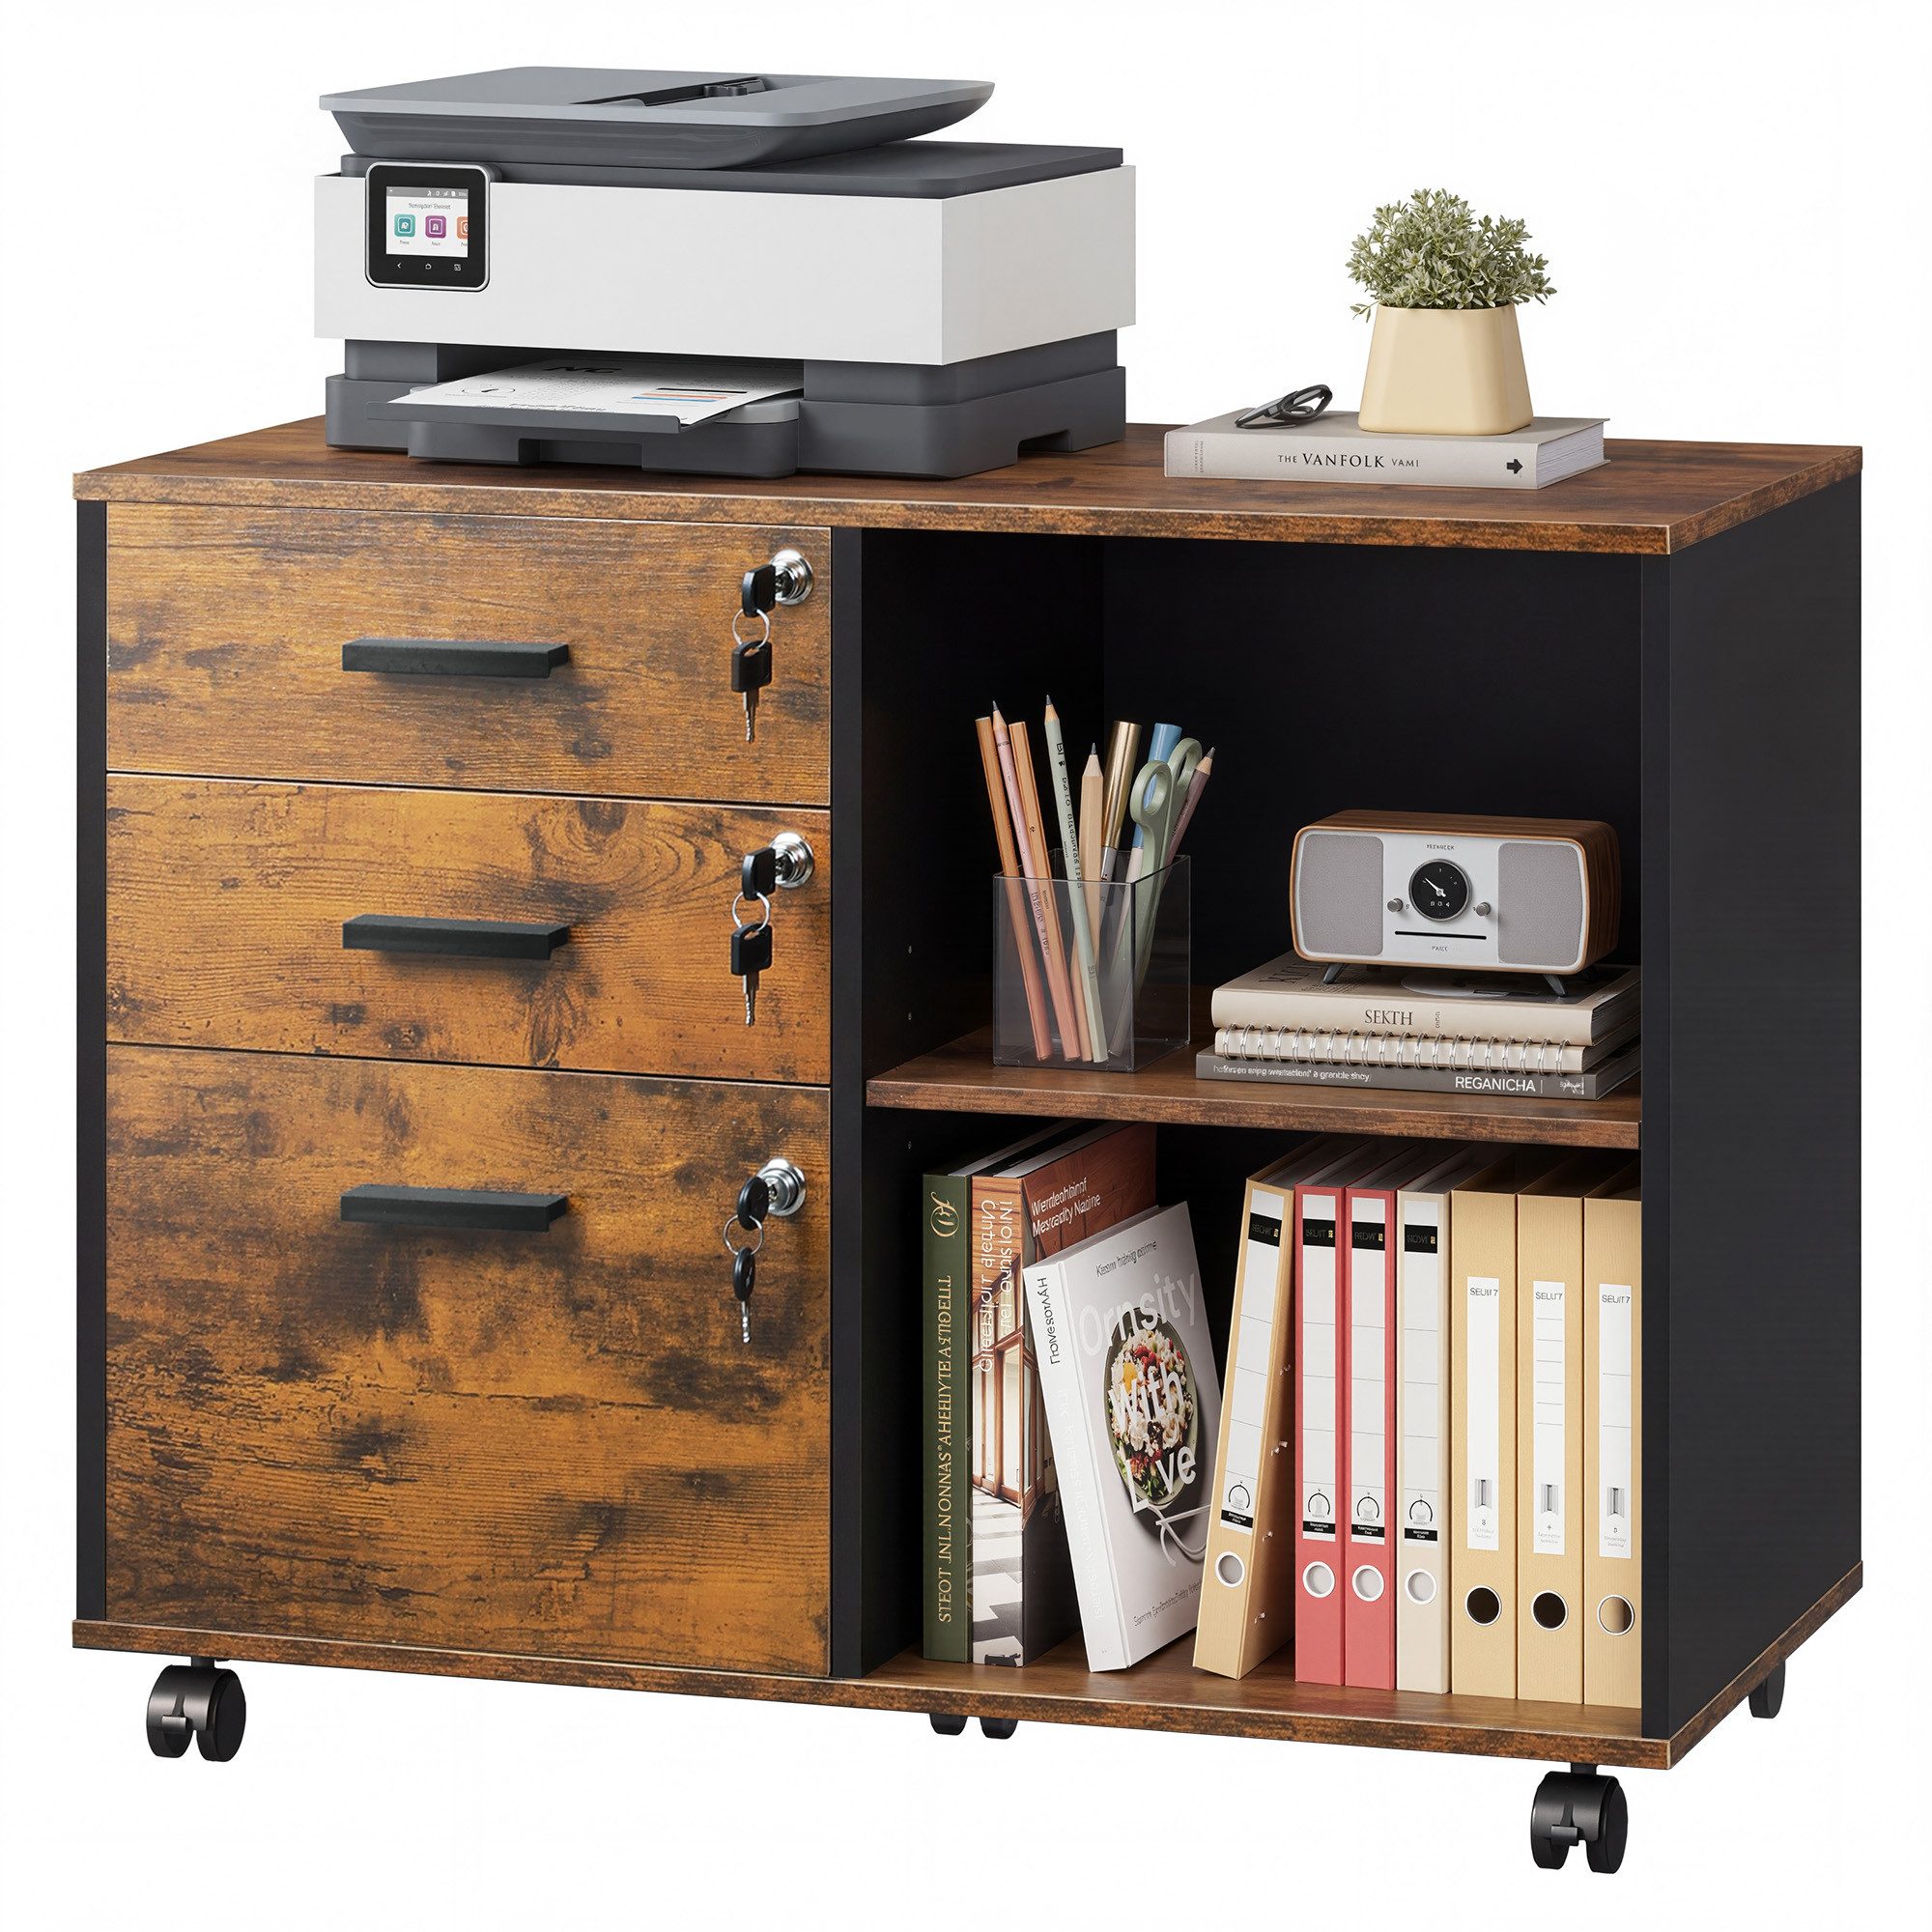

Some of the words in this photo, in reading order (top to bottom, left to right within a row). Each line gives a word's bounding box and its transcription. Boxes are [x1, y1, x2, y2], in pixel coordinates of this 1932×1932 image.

[1302, 453, 1385, 468] VANFOLK
[1392, 458, 1419, 467] VAMI
[1364, 1009, 1413, 1025] SEKTH
[1455, 1076, 1536, 1093] REGANICHA
